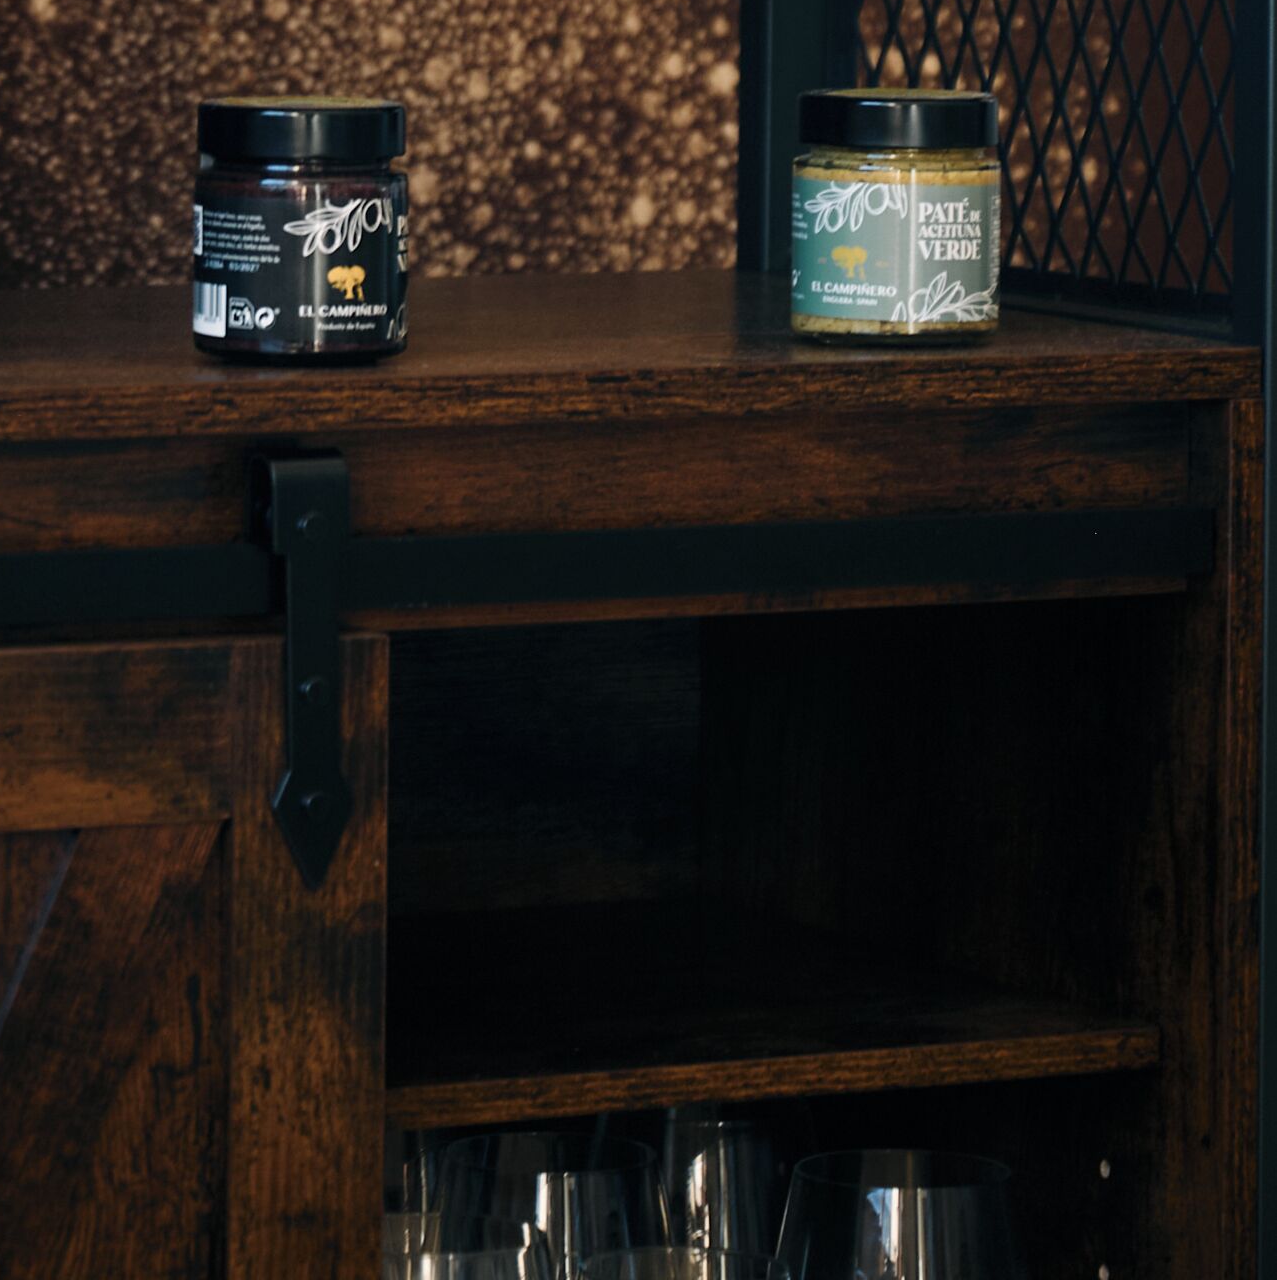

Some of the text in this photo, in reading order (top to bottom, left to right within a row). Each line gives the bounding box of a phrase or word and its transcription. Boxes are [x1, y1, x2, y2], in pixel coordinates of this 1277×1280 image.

[917, 197, 970, 224] PATÉ
[917, 224, 982, 239] ACEITUNA
[917, 239, 982, 261] VERDE
[811, 280, 898, 298] EL CAMPIÑERO
[298, 302, 388, 318] EL CAMPIÑERO
